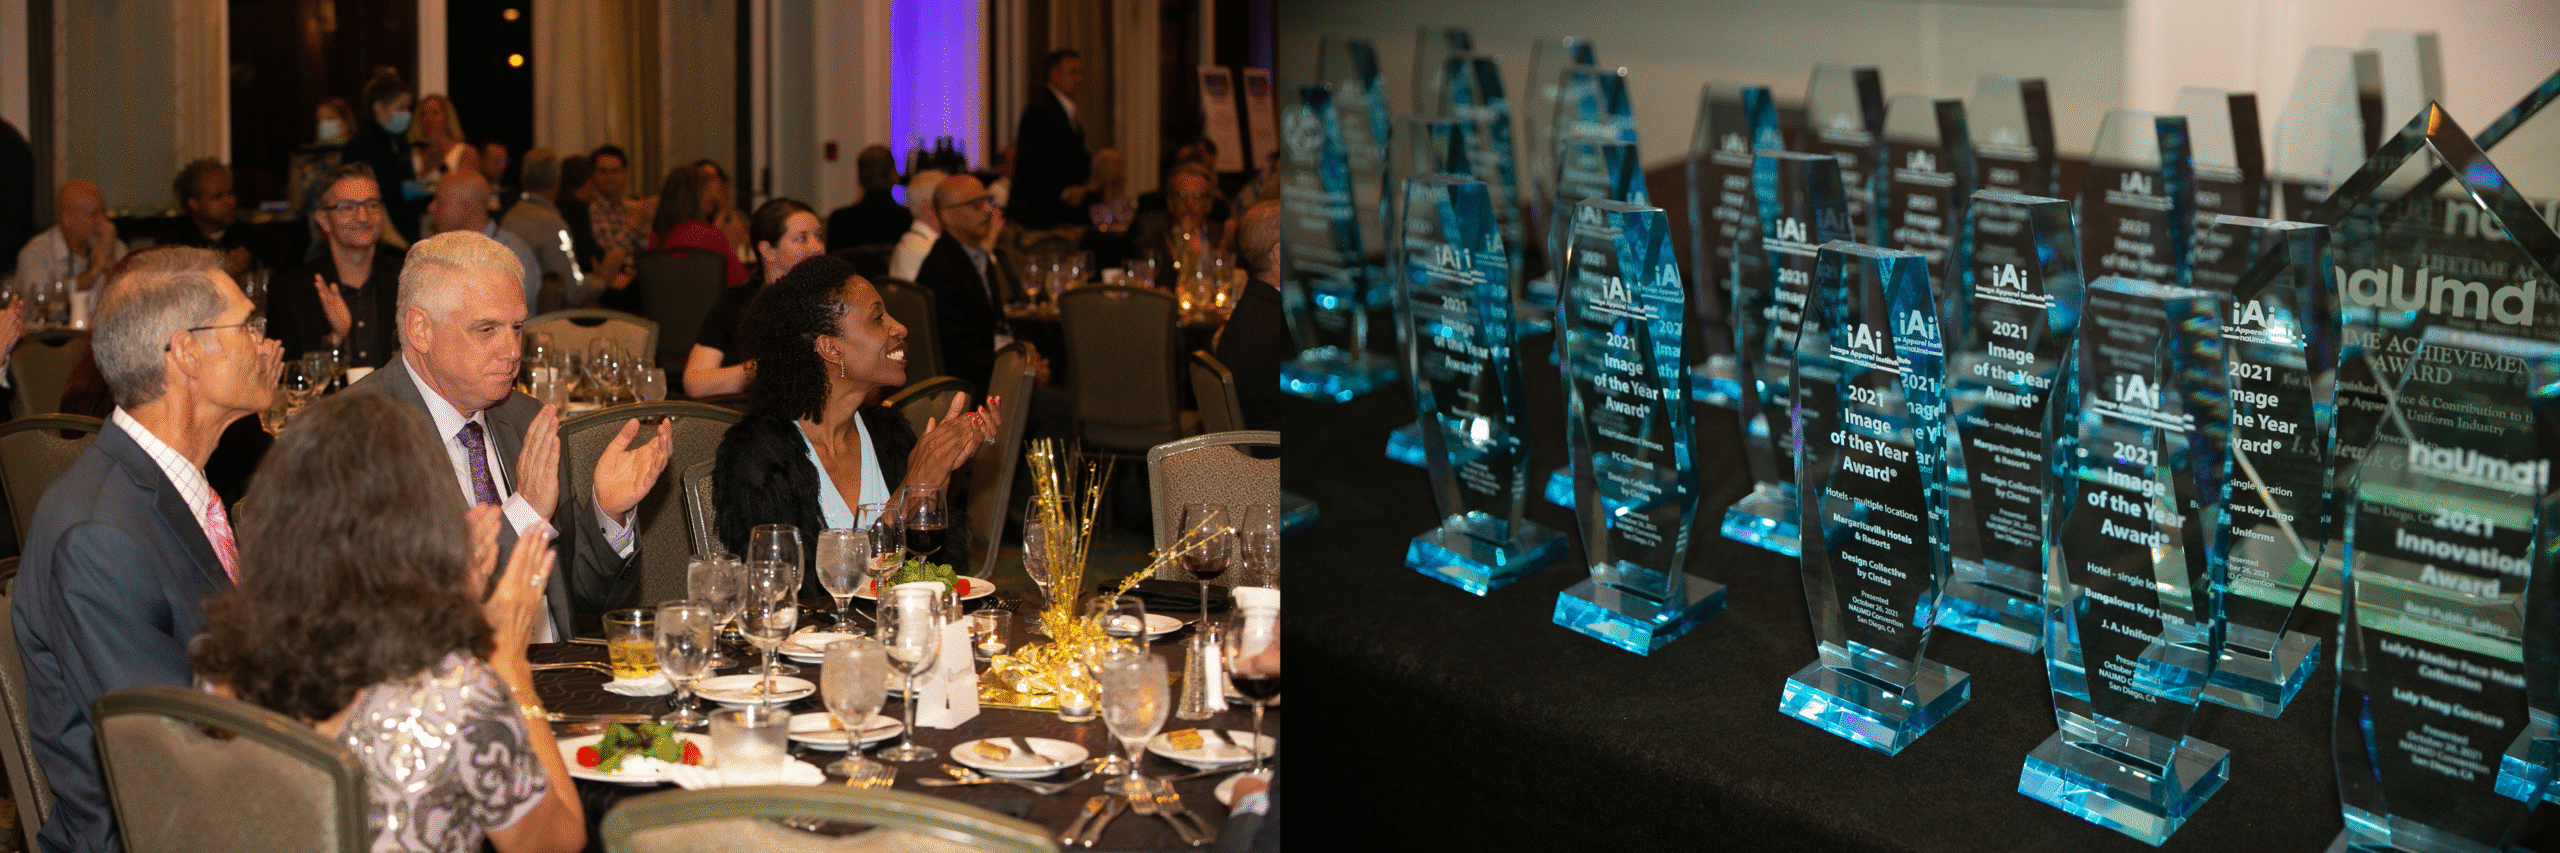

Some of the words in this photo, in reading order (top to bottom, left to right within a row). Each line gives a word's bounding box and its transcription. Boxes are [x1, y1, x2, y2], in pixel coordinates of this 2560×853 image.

[1602, 276, 1633, 304] iAi
[1993, 263, 2028, 292] iAi
[1775, 287, 1807, 309] Imag
[2233, 299, 2276, 330] iAi
[1606, 332, 1636, 351] 2021
[1847, 323, 1882, 354] iAi
[1992, 320, 2028, 340] 2021
[1604, 353, 1644, 377] Image
[1830, 345, 1850, 356] Image
[1850, 349, 1875, 361] Apparel
[1988, 341, 2035, 366] Image
[2387, 335, 2531, 375] ACHIEVEMEN
[1973, 362, 1989, 377] of
[1991, 365, 2016, 383] the
[2017, 369, 2051, 390] Year
[2229, 361, 2272, 382] 2021
[2372, 354, 2453, 385] AWARD
[1594, 373, 1607, 388] of
[1608, 375, 1630, 394] the
[1630, 380, 1659, 401] Year
[1848, 385, 1884, 408] 2021
[2115, 373, 2160, 410] iAi
[2230, 388, 2279, 409] mage
[2418, 393, 2430, 406] &
[2432, 396, 2508, 421] Contribution
[2510, 410, 2524, 422] to
[1844, 408, 1892, 435] Image
[2232, 409, 2255, 428] he
[2257, 413, 2298, 435] Year
[2407, 408, 2455, 428] Uniform
[2457, 417, 2506, 437] Industry
[1830, 430, 1846, 446] of
[1848, 434, 1874, 454] the
[1875, 439, 1910, 463] Year
[2113, 441, 2159, 468] 2021
[2107, 466, 2167, 498] Image
[2230, 478, 2256, 492] single
[1825, 487, 1849, 501] Hotels
[1853, 497, 1884, 512] multiple
[1884, 504, 1919, 522] locations
[2087, 490, 2109, 508] of
[2109, 494, 2142, 518] the
[2143, 502, 2187, 529] Year
[2247, 505, 2266, 519] Key
[2266, 508, 2295, 522] Largo
[1833, 513, 1887, 537] Margaritaville
[1886, 529, 1913, 545] Hotels
[2232, 526, 2275, 543] Uniforms
[2433, 507, 2495, 539] 2021
[1854, 532, 1862, 541] &
[1862, 534, 1891, 550] Resorts
[2395, 527, 2532, 578] Innovation
[1841, 551, 1868, 567] Design
[1868, 560, 1907, 580] Collective
[1856, 567, 1867, 580] by
[1867, 572, 1892, 586] Cintas
[2086, 561, 2112, 577] Hotel
[2117, 572, 2145, 588] single
[2419, 563, 2500, 600] Award
[1852, 596, 1875, 610] October
[1884, 607, 1899, 618] 2021
[1861, 590, 1890, 606] Presented
[2084, 587, 2136, 611] Bungalows
[2136, 603, 2156, 618] Key
[2156, 609, 2186, 626] Largo
[1848, 603, 1872, 617] NAUMD
[1871, 612, 1904, 629] Convention
[1857, 615, 1868, 625] San
[1887, 626, 1896, 635] CA
[2110, 622, 2121, 633] A.
[2121, 625, 2167, 648] Uniforms
[2098, 668, 2127, 685] NAUMD
[2104, 660, 2134, 676] October
[2109, 681, 2122, 694] San
[2145, 693, 2157, 704] CA
